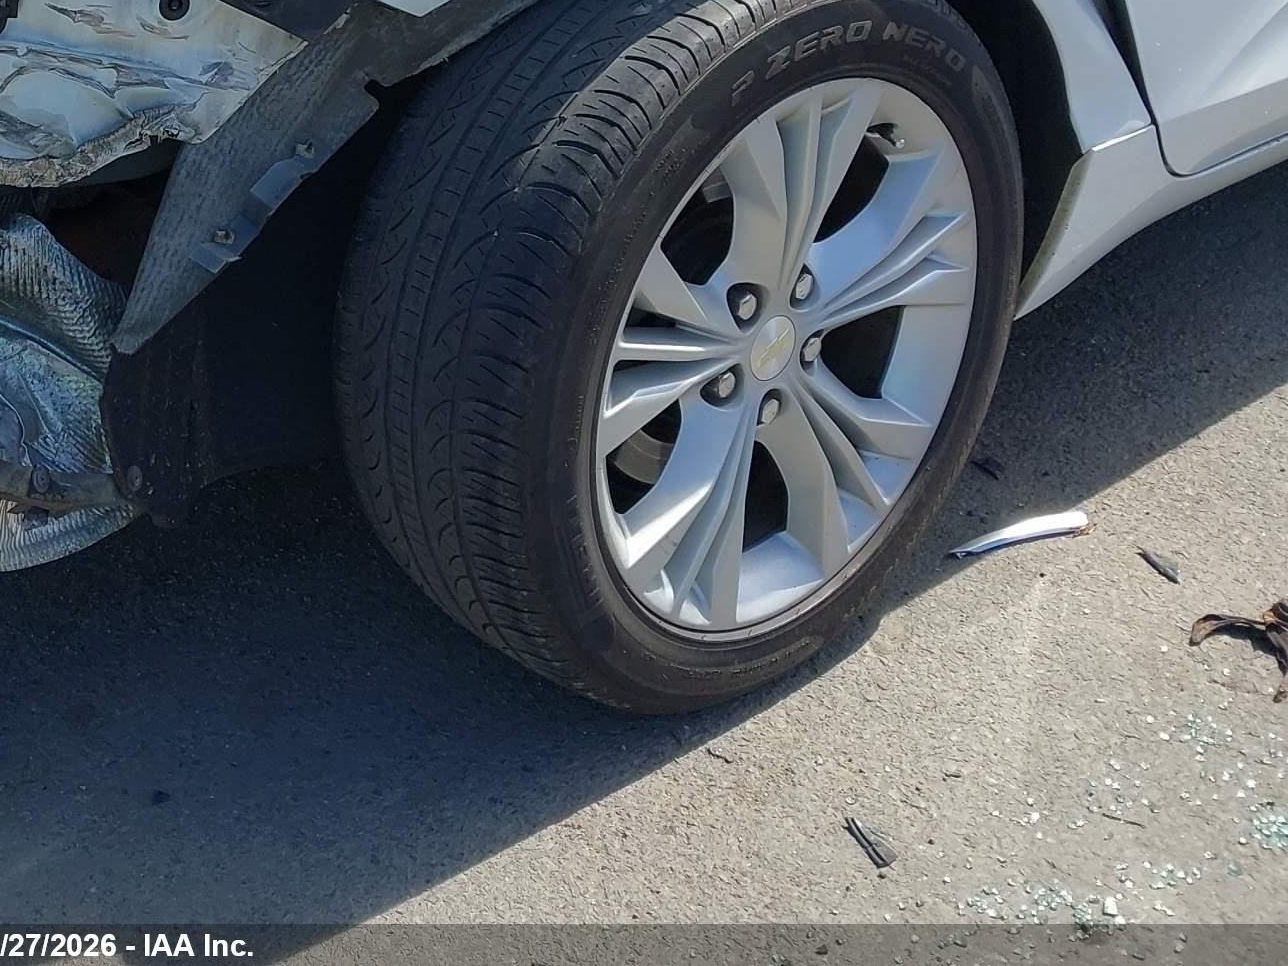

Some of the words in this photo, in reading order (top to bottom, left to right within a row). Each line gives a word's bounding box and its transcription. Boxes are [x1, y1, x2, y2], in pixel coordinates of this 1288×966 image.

[731, 70, 755, 107] P
[765, 20, 873, 80] ZERO
[882, 20, 967, 72] NERO
